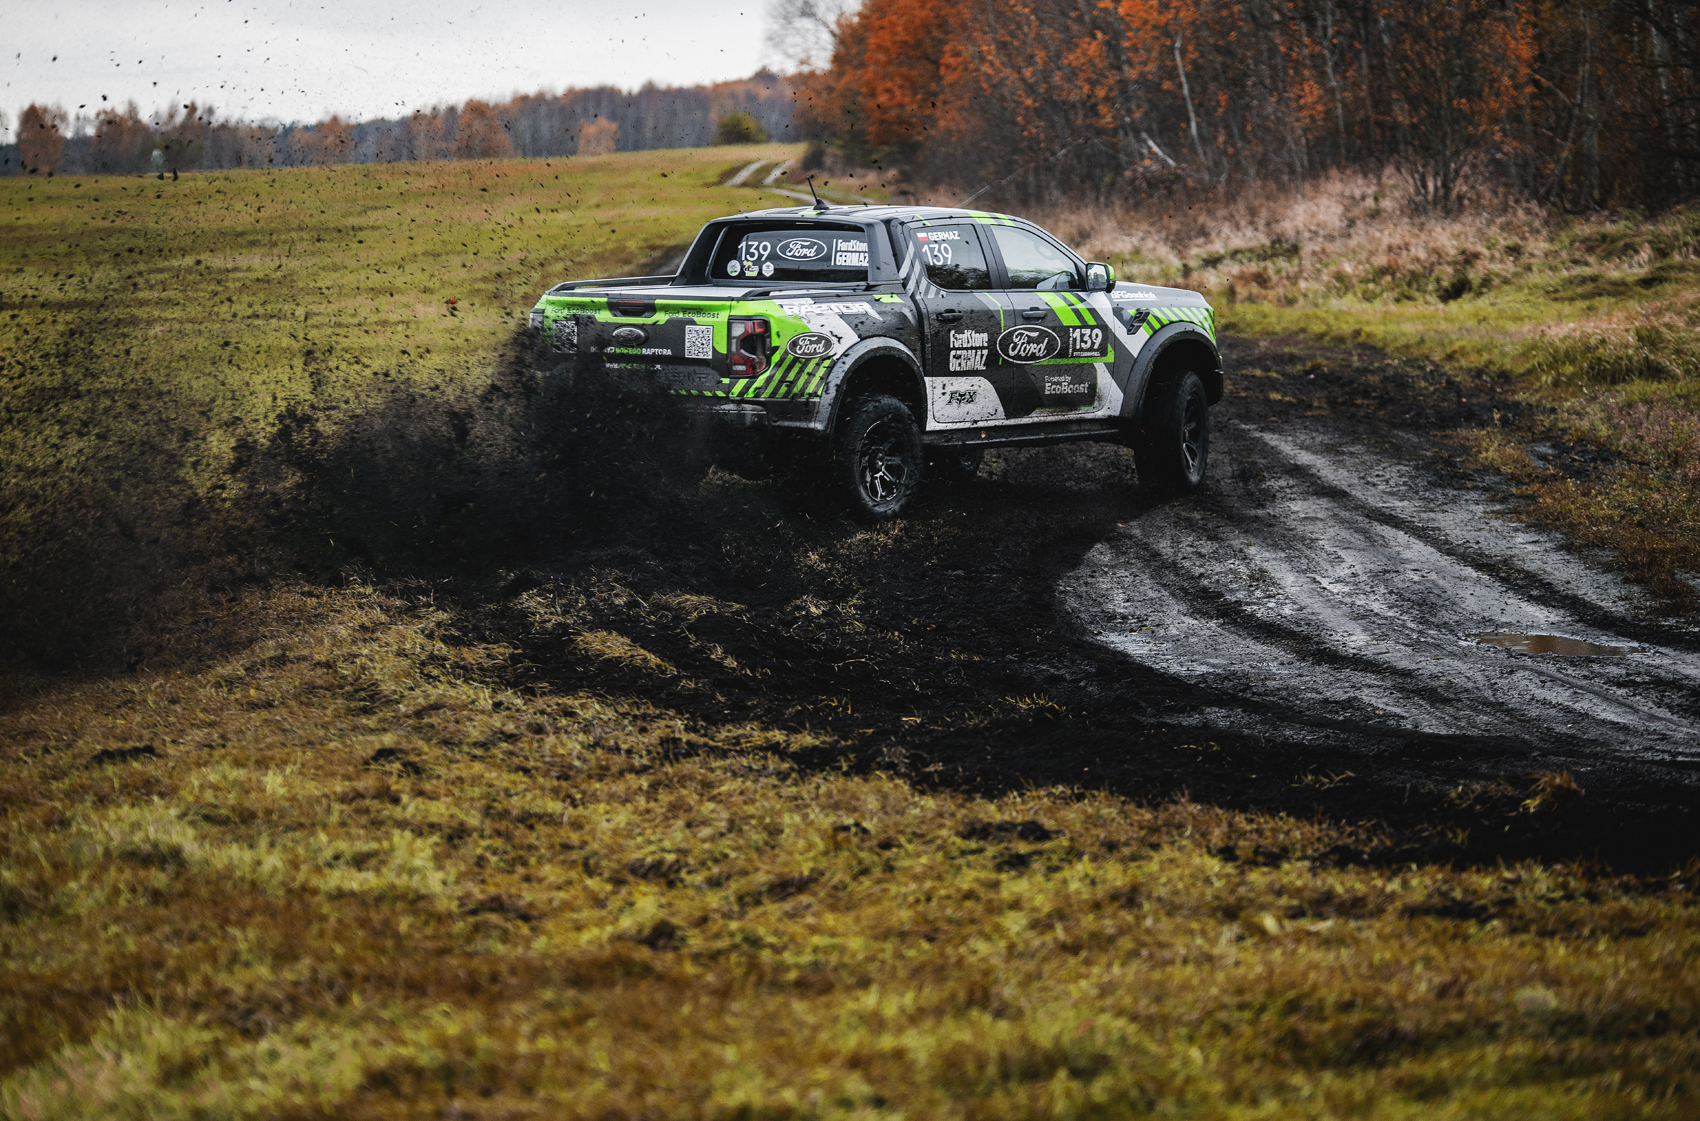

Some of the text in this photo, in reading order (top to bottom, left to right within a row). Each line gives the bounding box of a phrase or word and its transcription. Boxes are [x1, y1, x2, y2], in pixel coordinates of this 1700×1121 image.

[836, 239, 869, 251] FordStor
[927, 230, 961, 241] GERMAZ
[737, 241, 771, 261] 139
[785, 241, 818, 258] Ford
[835, 251, 869, 267] GERMAZ
[921, 243, 953, 266] 139
[1110, 290, 1158, 300] BFGoodrich
[681, 310, 720, 319] EcoBoost
[780, 300, 884, 322] RAPTOR
[795, 336, 826, 355] Ford
[949, 329, 989, 348] FordStore
[1008, 329, 1049, 357] Ford
[1072, 328, 1103, 350] 139
[948, 349, 989, 372] GERMAZ
[1044, 381, 1089, 395] EcoBoost
